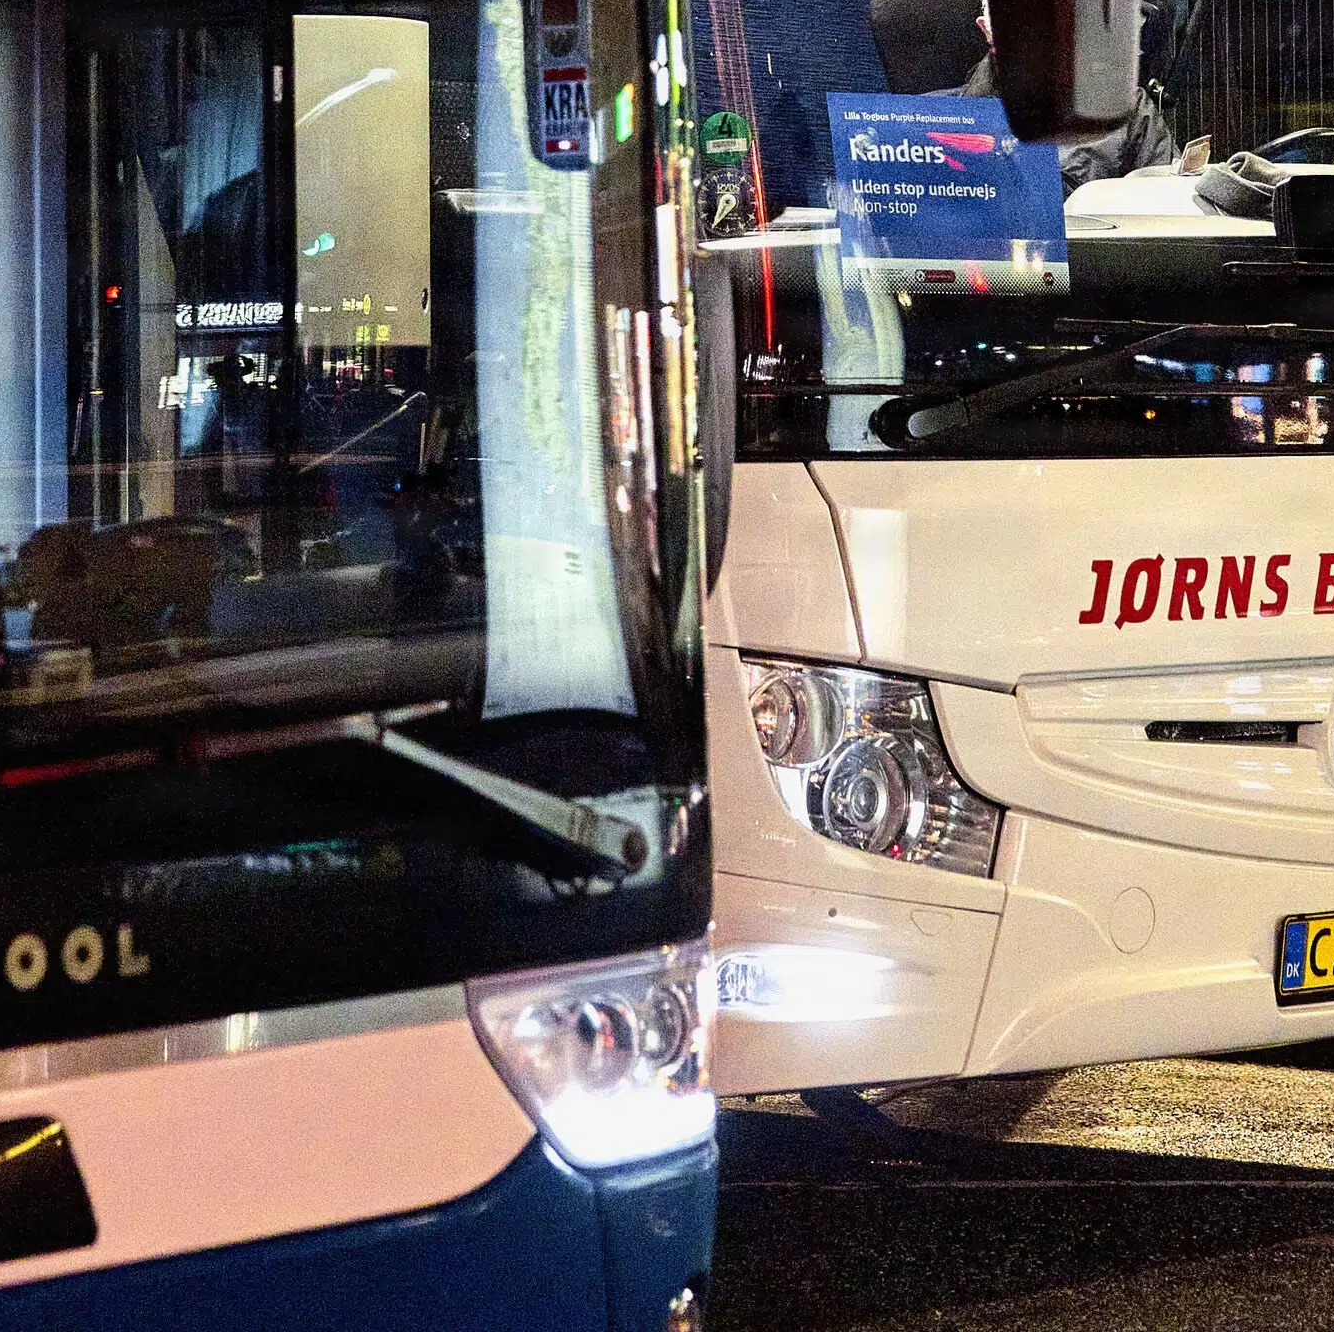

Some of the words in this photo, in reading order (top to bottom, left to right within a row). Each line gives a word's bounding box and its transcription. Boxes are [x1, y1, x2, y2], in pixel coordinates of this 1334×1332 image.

[890, 113, 915, 122] Purple
[852, 179, 890, 196] Uden
[894, 182, 924, 199] stop
[929, 183, 997, 201] undervejs
[854, 199, 917, 217] Non-stop
[1078, 553, 1292, 630] JØRNS
[1286, 962, 1300, 977] DK
